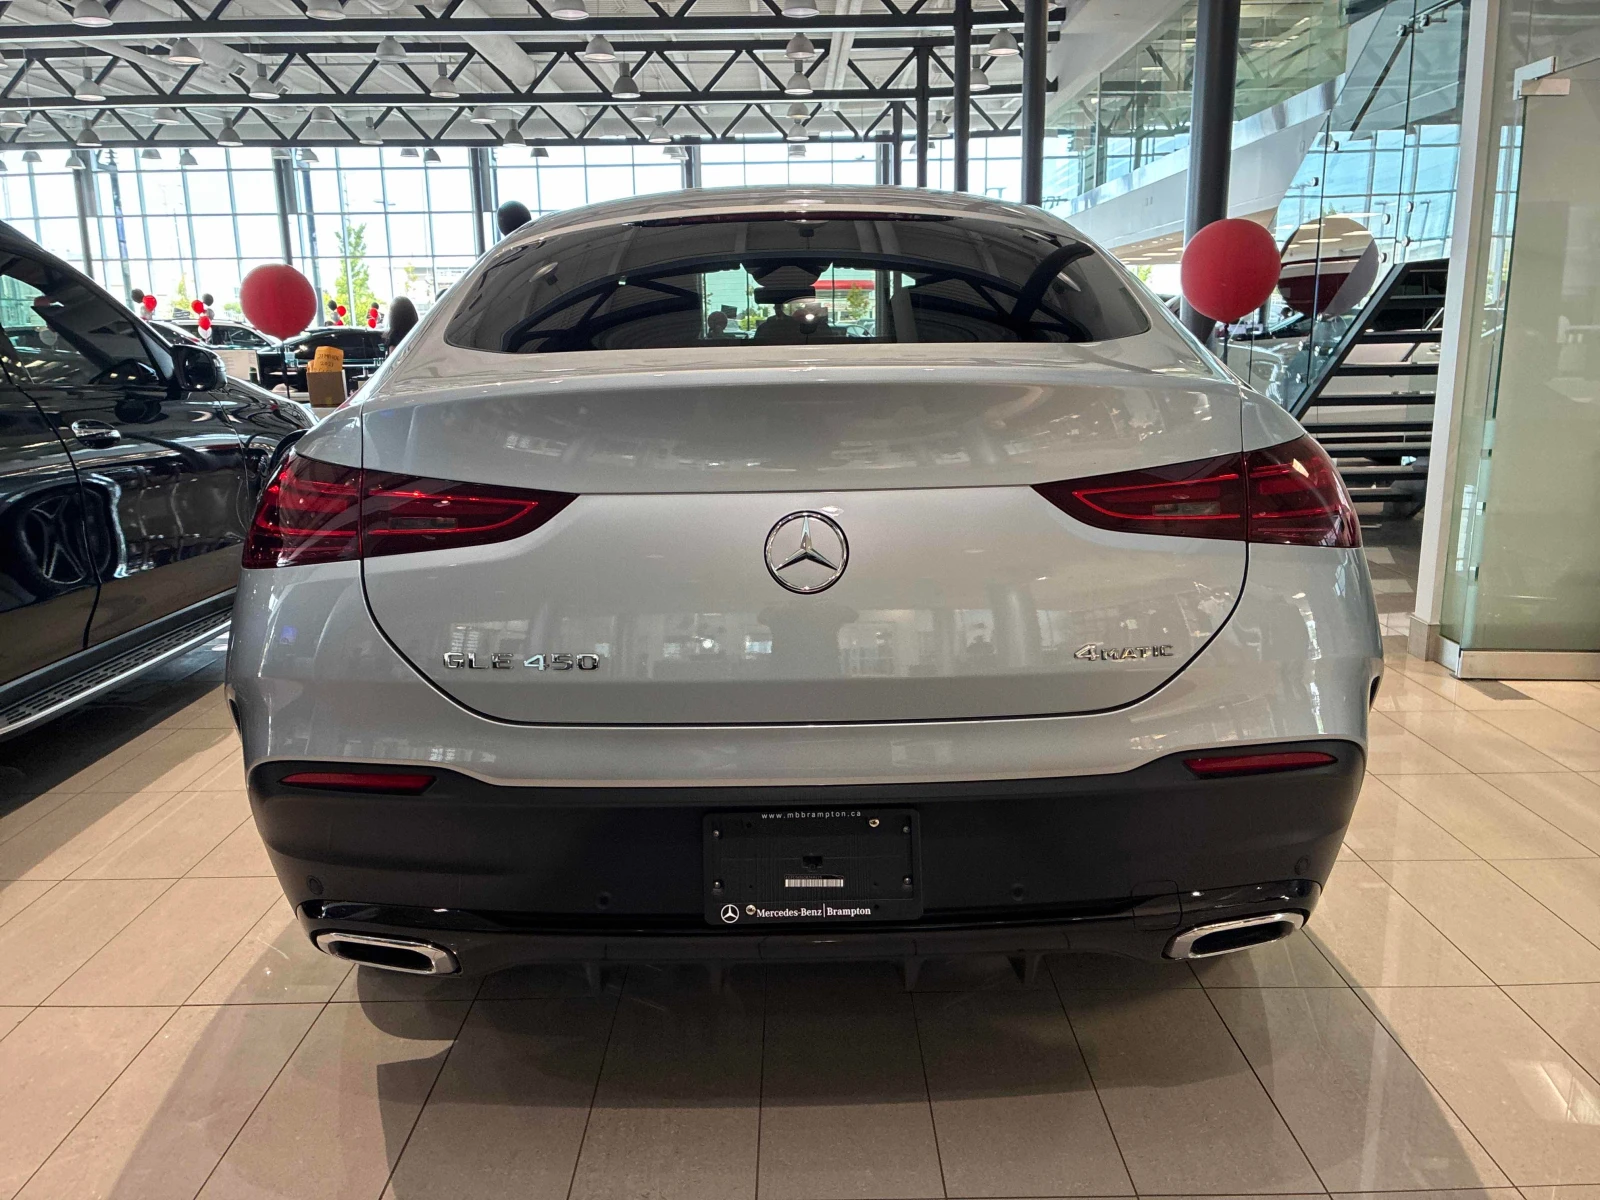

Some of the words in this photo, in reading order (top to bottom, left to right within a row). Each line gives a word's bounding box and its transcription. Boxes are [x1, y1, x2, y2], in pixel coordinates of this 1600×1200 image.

[1074, 644, 1174, 661] 4MATIC
[443, 652, 514, 669] GLE
[523, 653, 600, 671] 450
[761, 811, 861, 819] www.mbbrampton.ca
[756, 908, 822, 918] Mercedes-Benz
[826, 907, 871, 917] Brampton
